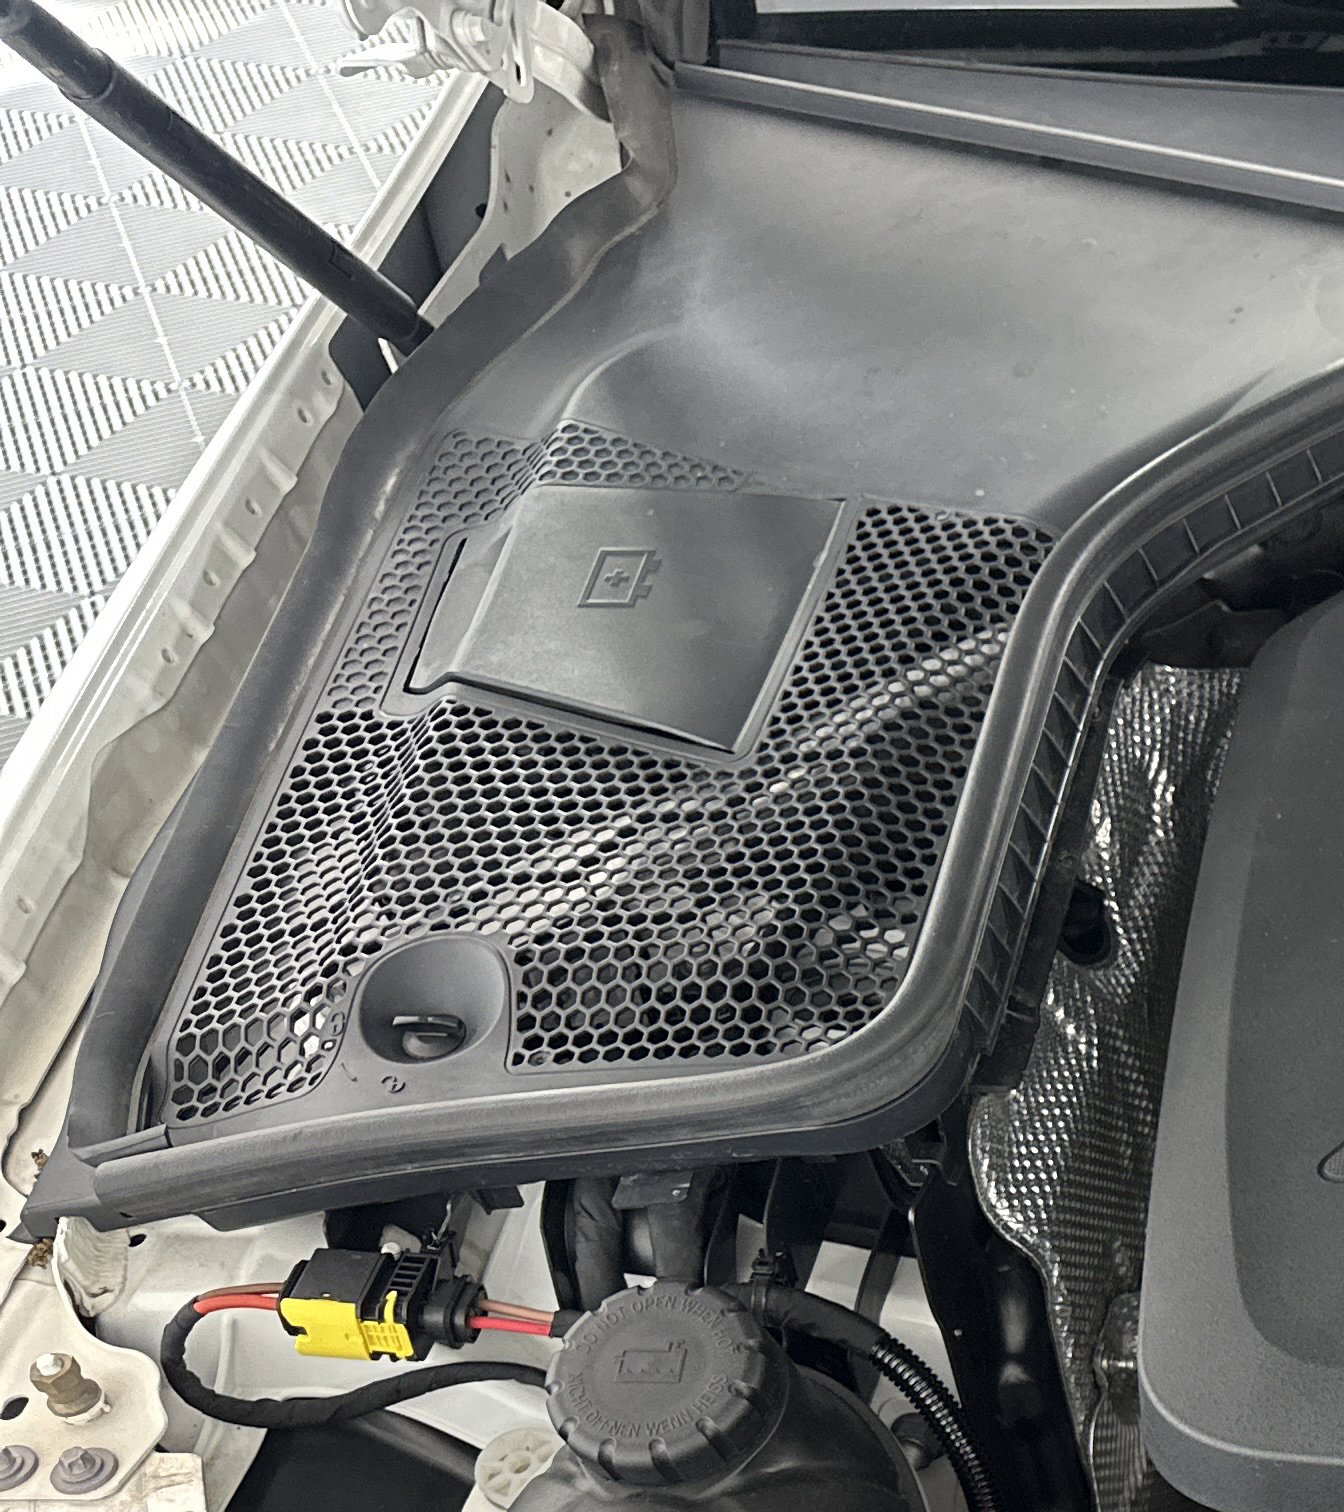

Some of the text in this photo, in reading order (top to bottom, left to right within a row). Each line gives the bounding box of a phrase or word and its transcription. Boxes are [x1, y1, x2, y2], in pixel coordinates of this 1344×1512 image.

[632, 1295, 677, 1313] OPEN
[681, 1297, 721, 1329] WHEN
[568, 1372, 593, 1414] NICHT
[646, 1408, 694, 1437] WENN
[692, 1373, 729, 1414] HEISS
